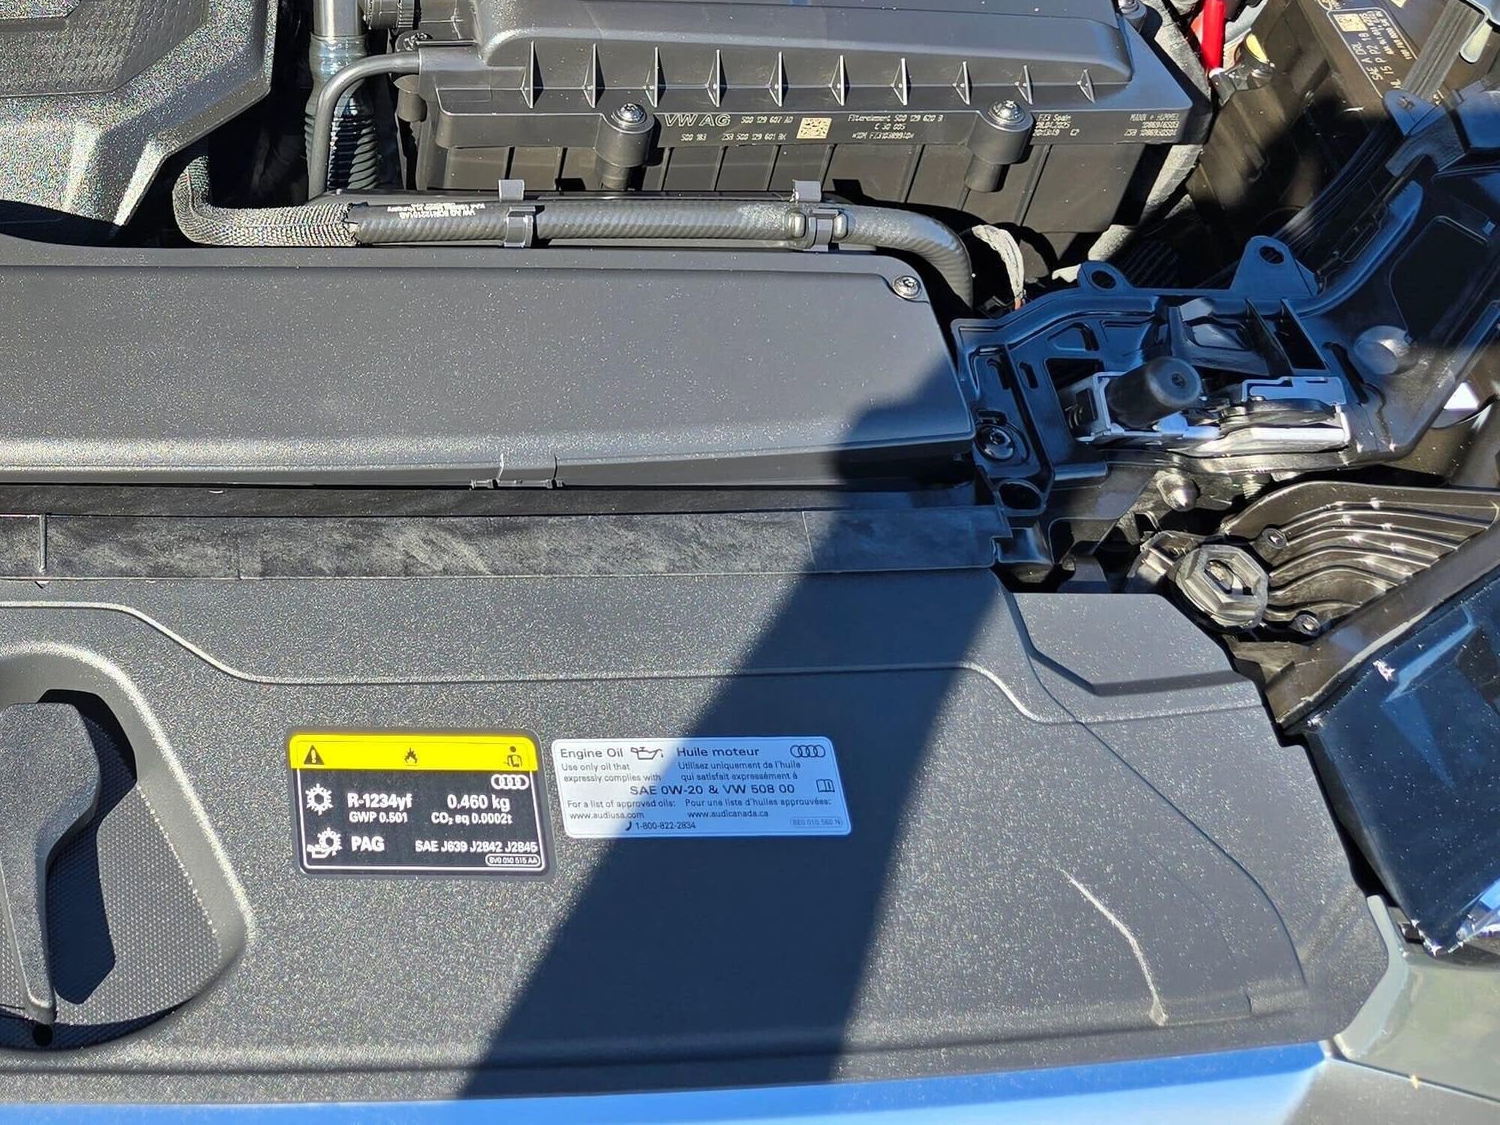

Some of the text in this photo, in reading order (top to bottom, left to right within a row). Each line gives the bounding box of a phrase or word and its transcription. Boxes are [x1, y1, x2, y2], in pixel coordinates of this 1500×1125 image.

[664, 114, 731, 126] VW AG
[1053, 114, 1071, 122] Spain
[560, 747, 760, 760] Engine Oil Huile moteur
[562, 762, 630, 773] Use only oil that
[710, 762, 760, 772] uniquement
[564, 774, 601, 784] expressly
[602, 774, 640, 784] complies
[680, 773, 694, 783] qui
[731, 772, 791, 783] expressément
[630, 784, 795, 795] SAE 0W-20 & VW 508 00
[347, 793, 413, 811] R-1234yf
[492, 794, 510, 812] kg
[616, 800, 657, 810] approved
[745, 798, 778, 806] d'huiles
[349, 811, 377, 823] GWP
[455, 815, 470, 825] eq
[569, 810, 769, 820] www.audiusa.com www.audicanada.ca
[351, 836, 538, 852] PAG SAE J639 J2842 J2845
